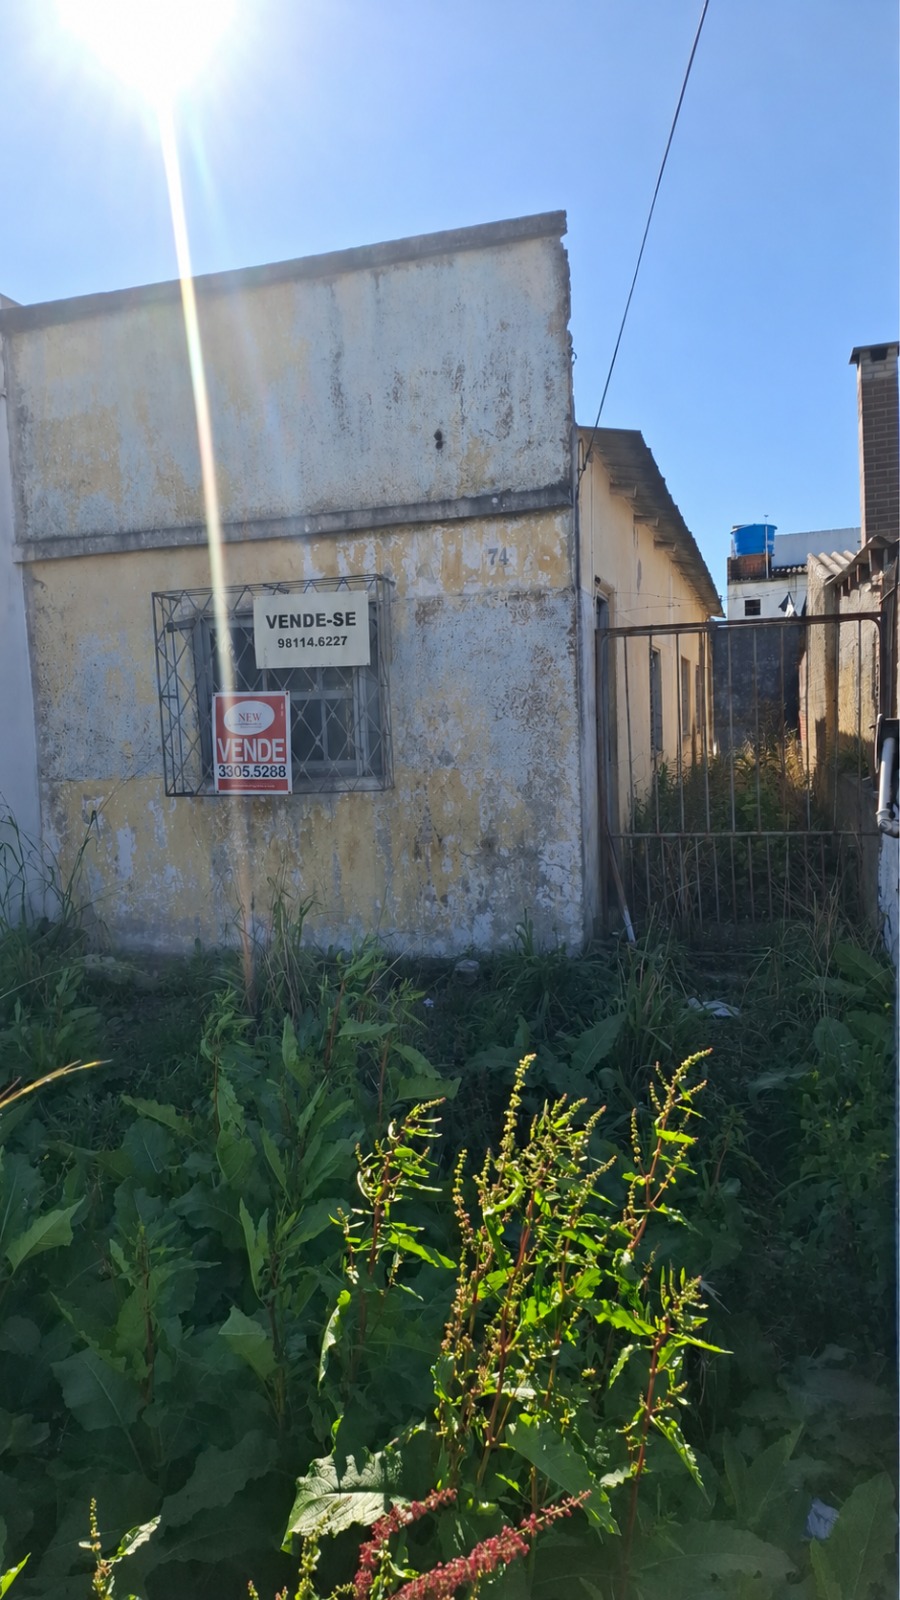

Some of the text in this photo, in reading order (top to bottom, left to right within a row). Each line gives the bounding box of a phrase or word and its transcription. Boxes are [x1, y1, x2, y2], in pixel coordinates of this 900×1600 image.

[488, 547, 509, 565] 74
[265, 611, 356, 629] VENDE-SE
[277, 636, 348, 648] 98114.6227
[238, 712, 262, 722] NEW
[217, 738, 285, 762] VENDE
[218, 765, 286, 778] 3305.5288
